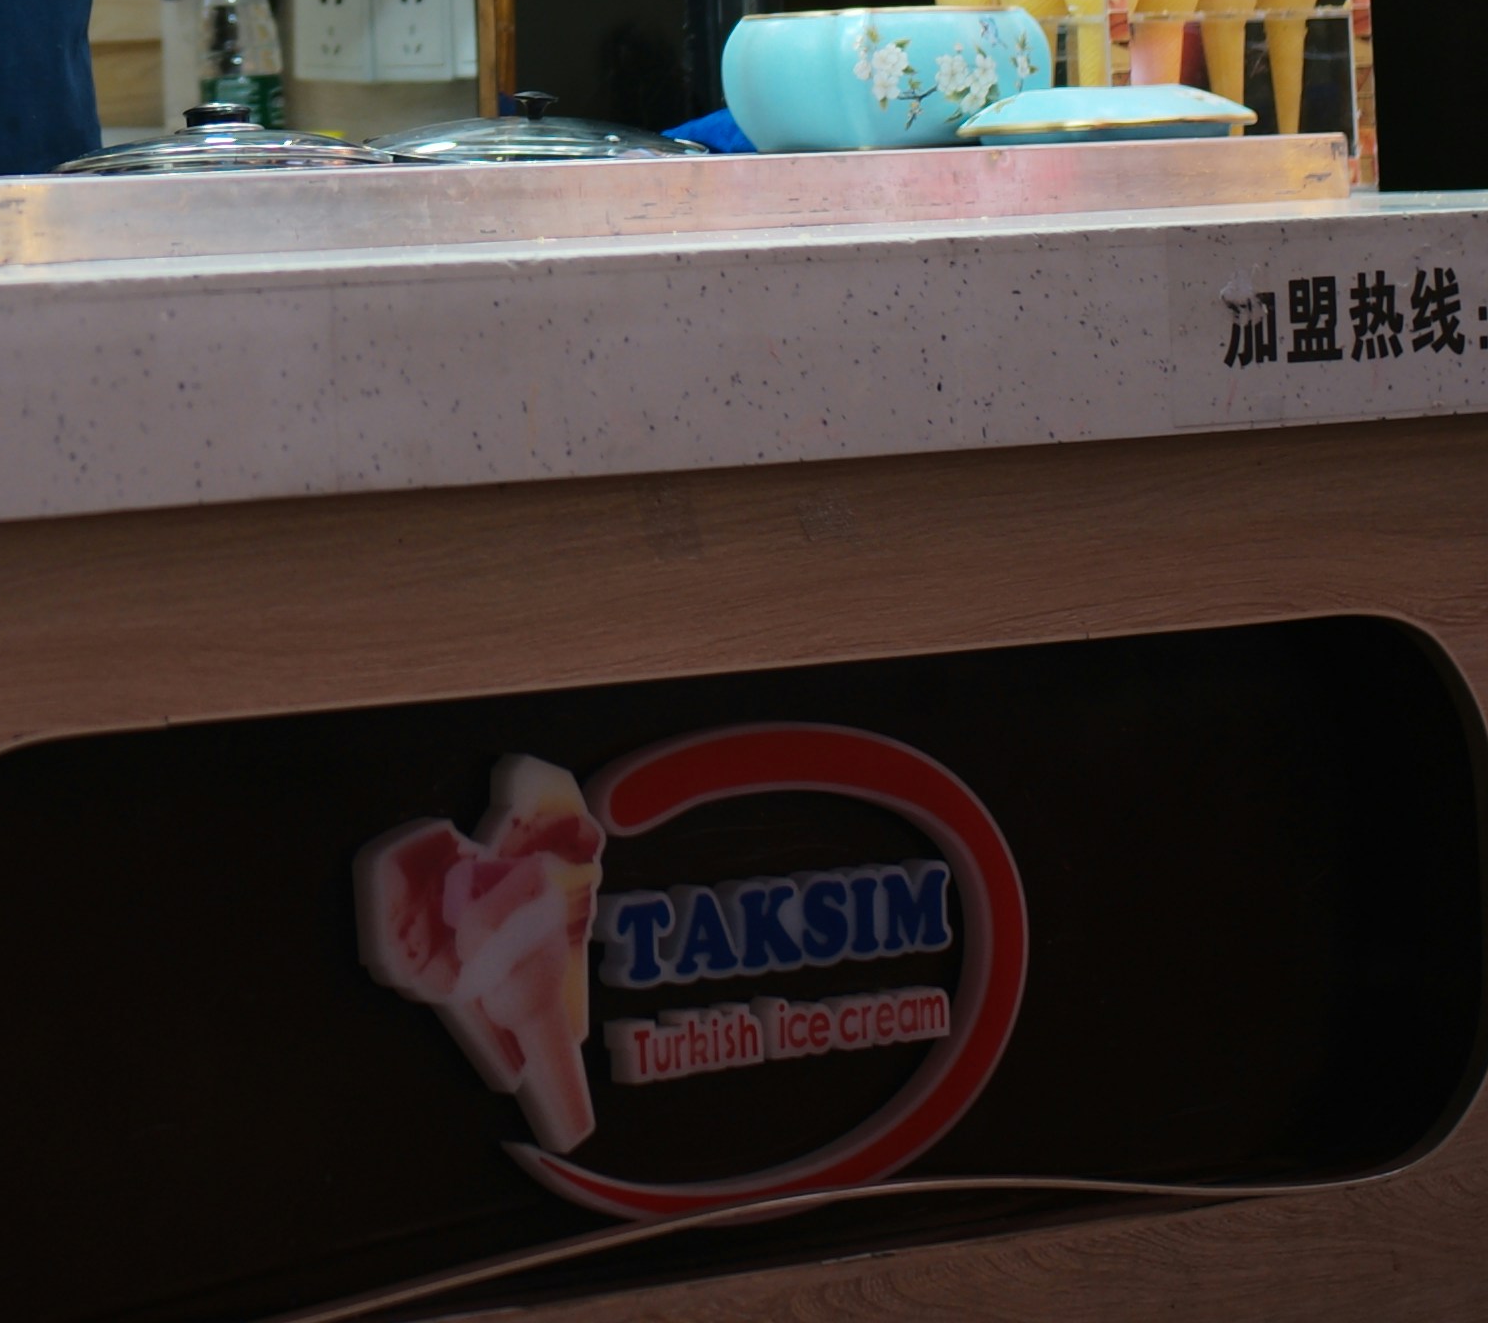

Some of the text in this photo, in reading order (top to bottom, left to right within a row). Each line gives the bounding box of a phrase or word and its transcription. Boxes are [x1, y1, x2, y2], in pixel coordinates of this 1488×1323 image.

[616, 867, 950, 984] TAKSIM
[633, 993, 947, 1075] Turkish ice cream
